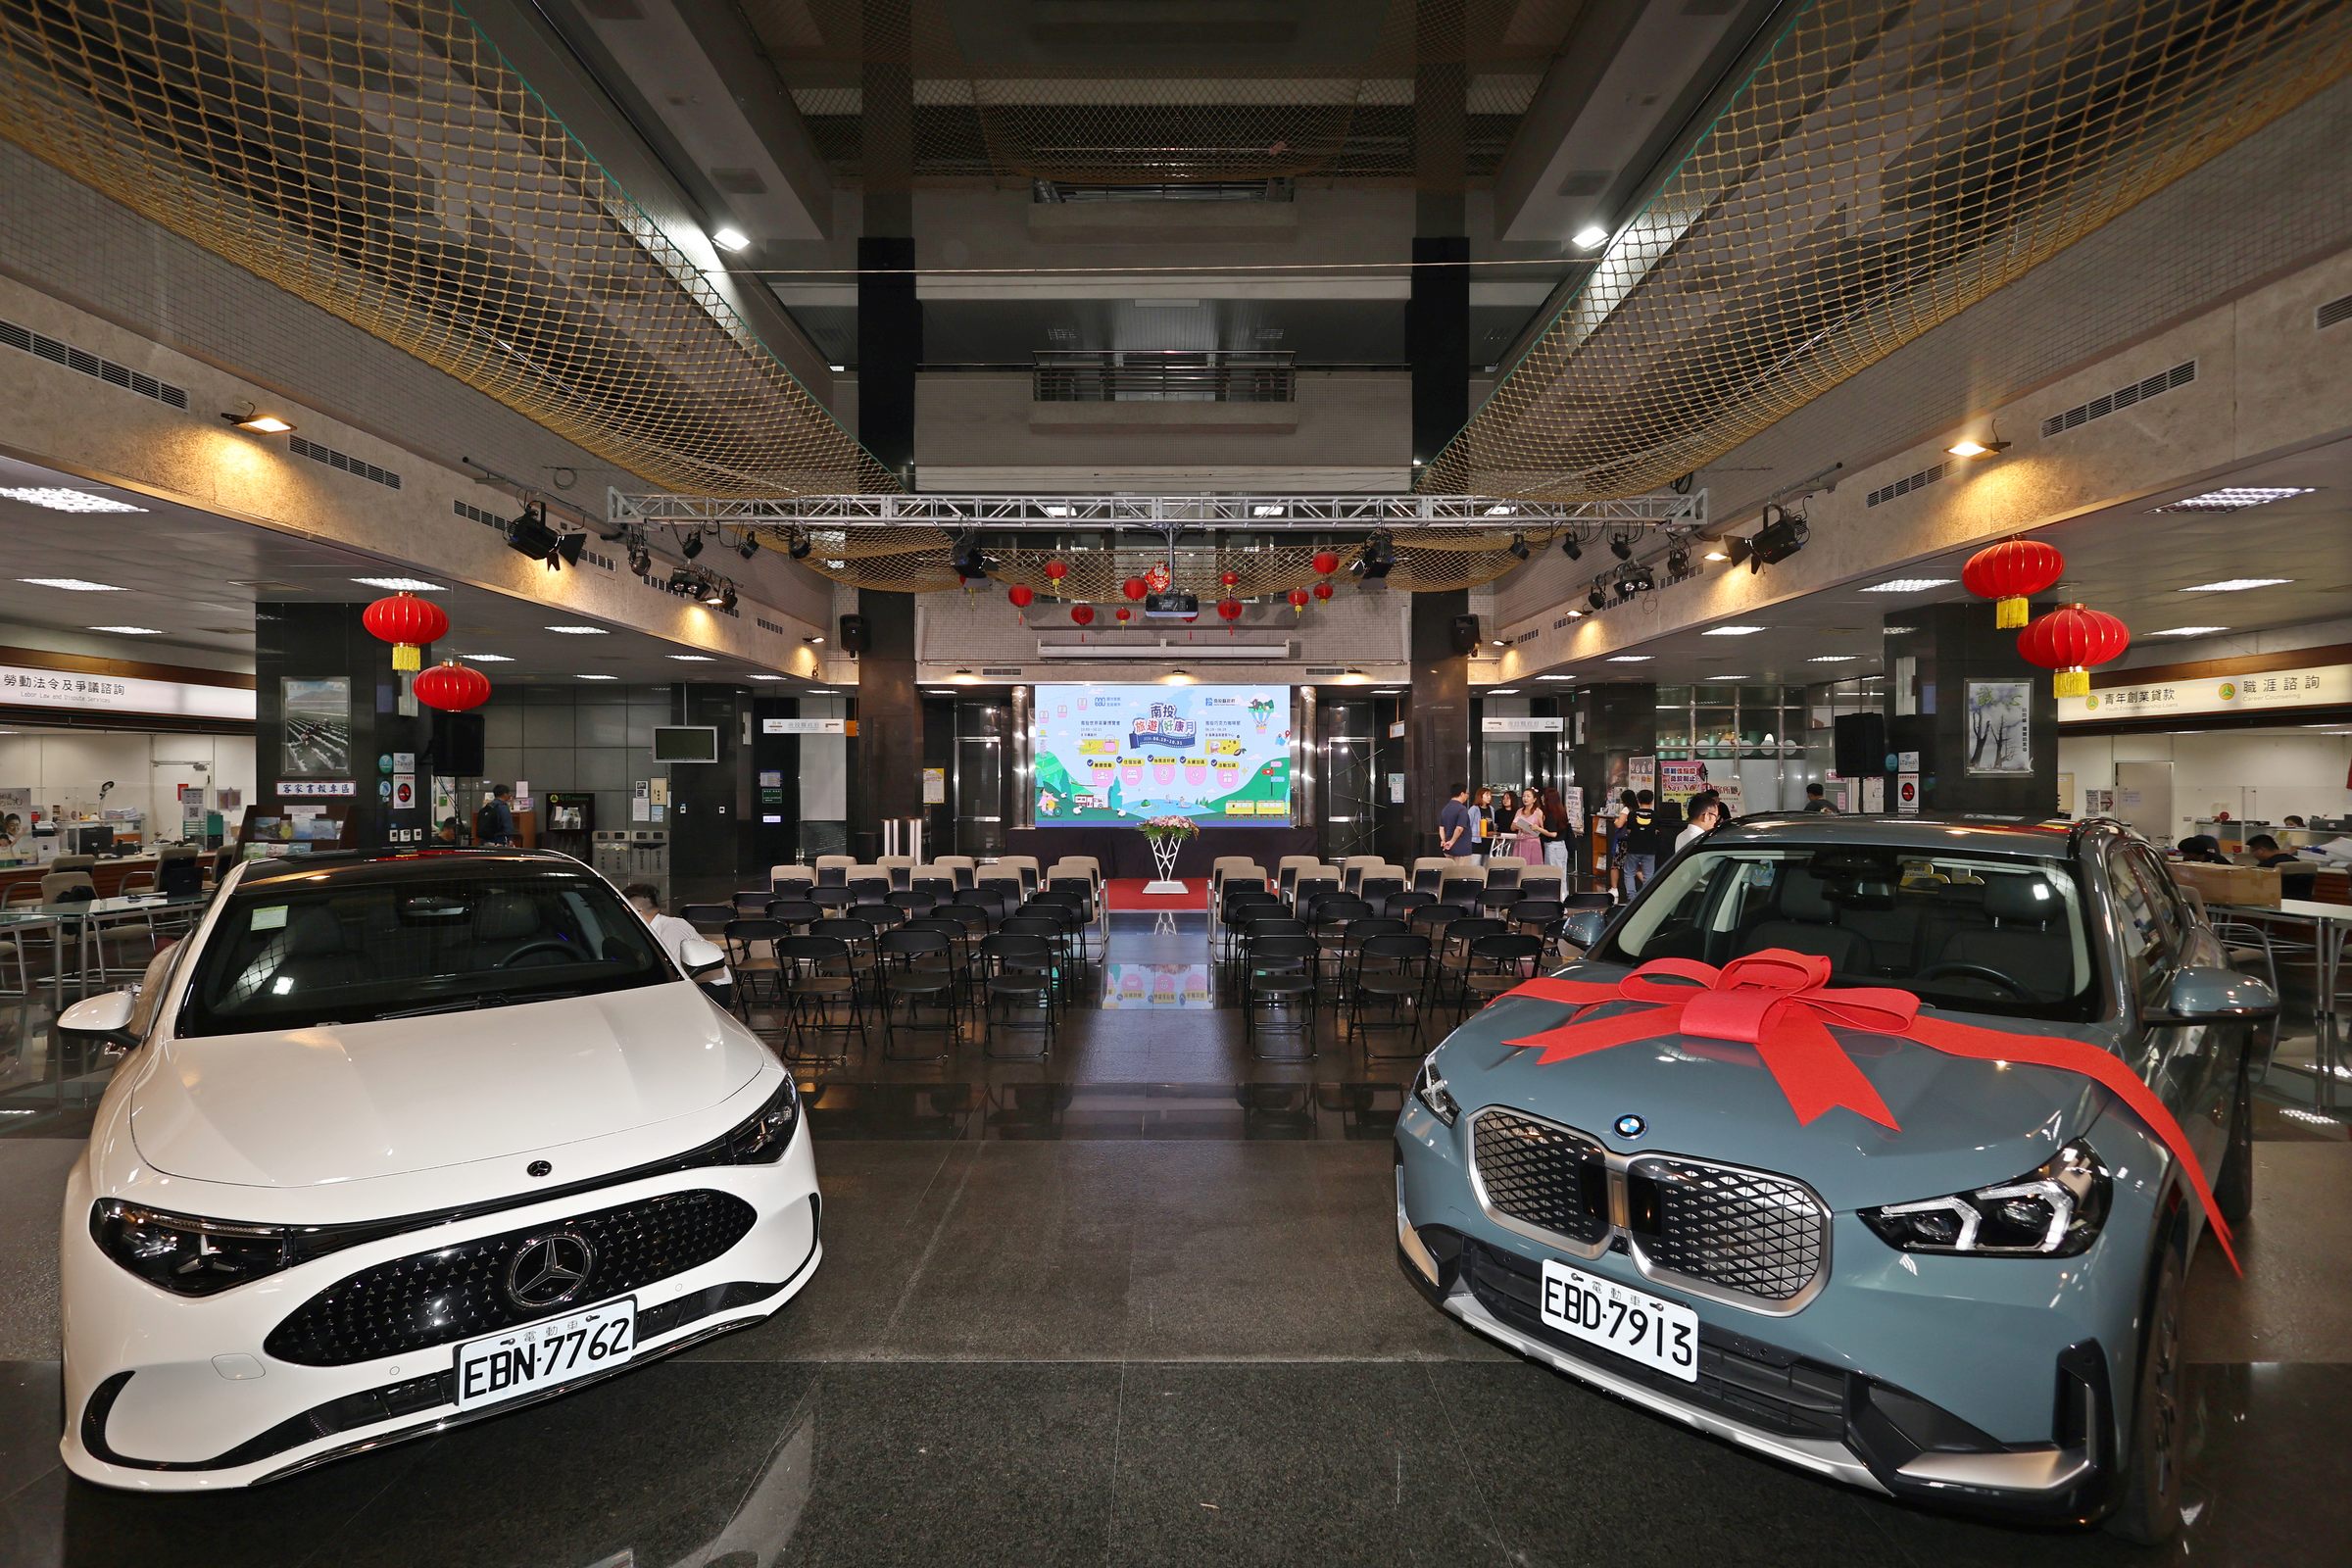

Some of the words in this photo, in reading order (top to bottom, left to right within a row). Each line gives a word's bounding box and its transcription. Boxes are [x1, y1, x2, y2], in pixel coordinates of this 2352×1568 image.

[4, 673, 125, 696] 勞動法令及爭議諮詢
[2243, 674, 2320, 694] 職涯諮詢
[64, 694, 85, 703] Dispute
[2104, 688, 2175, 705] 青年創業貸款
[1151, 705, 1175, 718] 南投
[1135, 719, 1194, 733] 旅遊好康月
[282, 783, 350, 794] 客家書報專區
[1592, 1280, 1641, 1307] 電動車
[522, 1319, 579, 1343] 電動車
[1544, 1275, 1692, 1367] EBD-7913
[464, 1317, 630, 1400] EBN-7762
